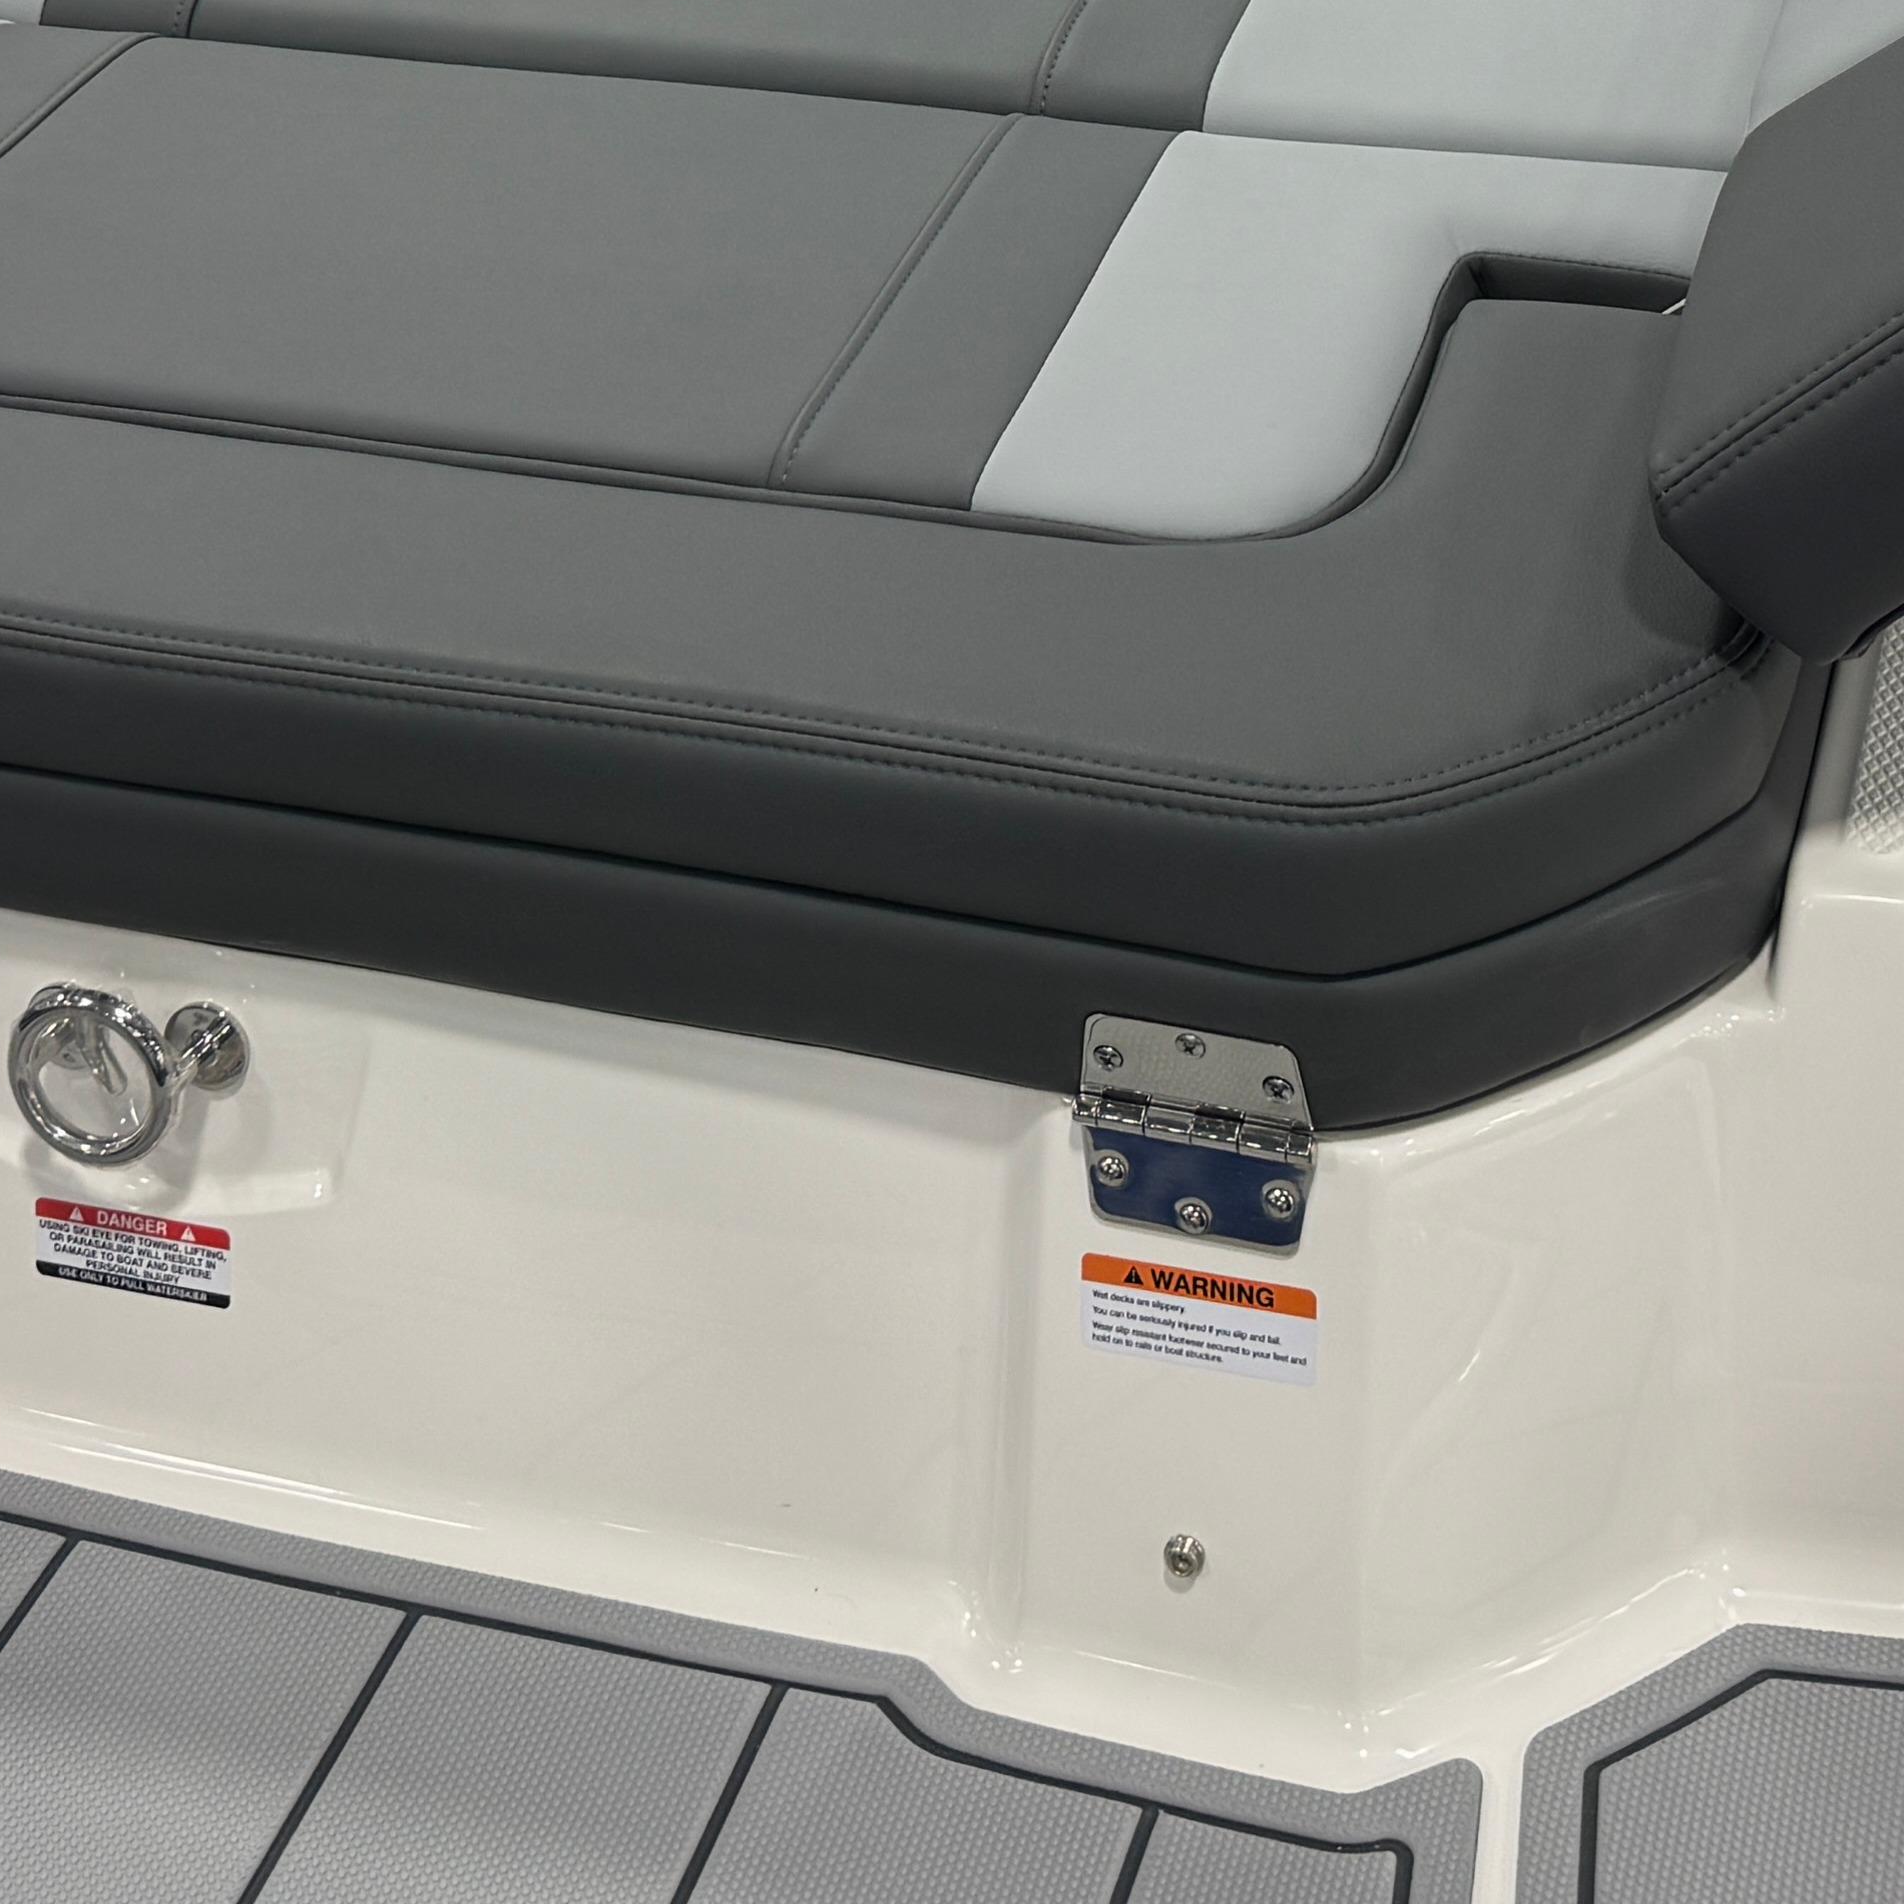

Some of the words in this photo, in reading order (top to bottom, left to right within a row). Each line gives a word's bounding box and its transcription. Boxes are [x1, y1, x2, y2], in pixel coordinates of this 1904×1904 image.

[92, 1228, 112, 1241] EYE
[115, 1232, 135, 1244] FOR
[97, 1210, 168, 1236] DANGER
[49, 1231, 64, 1242] OR
[137, 1248, 161, 1260] WILL
[205, 1260, 216, 1269] IN
[54, 1243, 98, 1258] DAMAGE
[101, 1251, 114, 1262] TO
[116, 1254, 143, 1267] BOAT
[146, 1260, 168, 1272] AND
[86, 1259, 140, 1277] PERSONAL
[1151, 1268, 1275, 1309] WARNING
[1092, 1305, 1108, 1316] You
